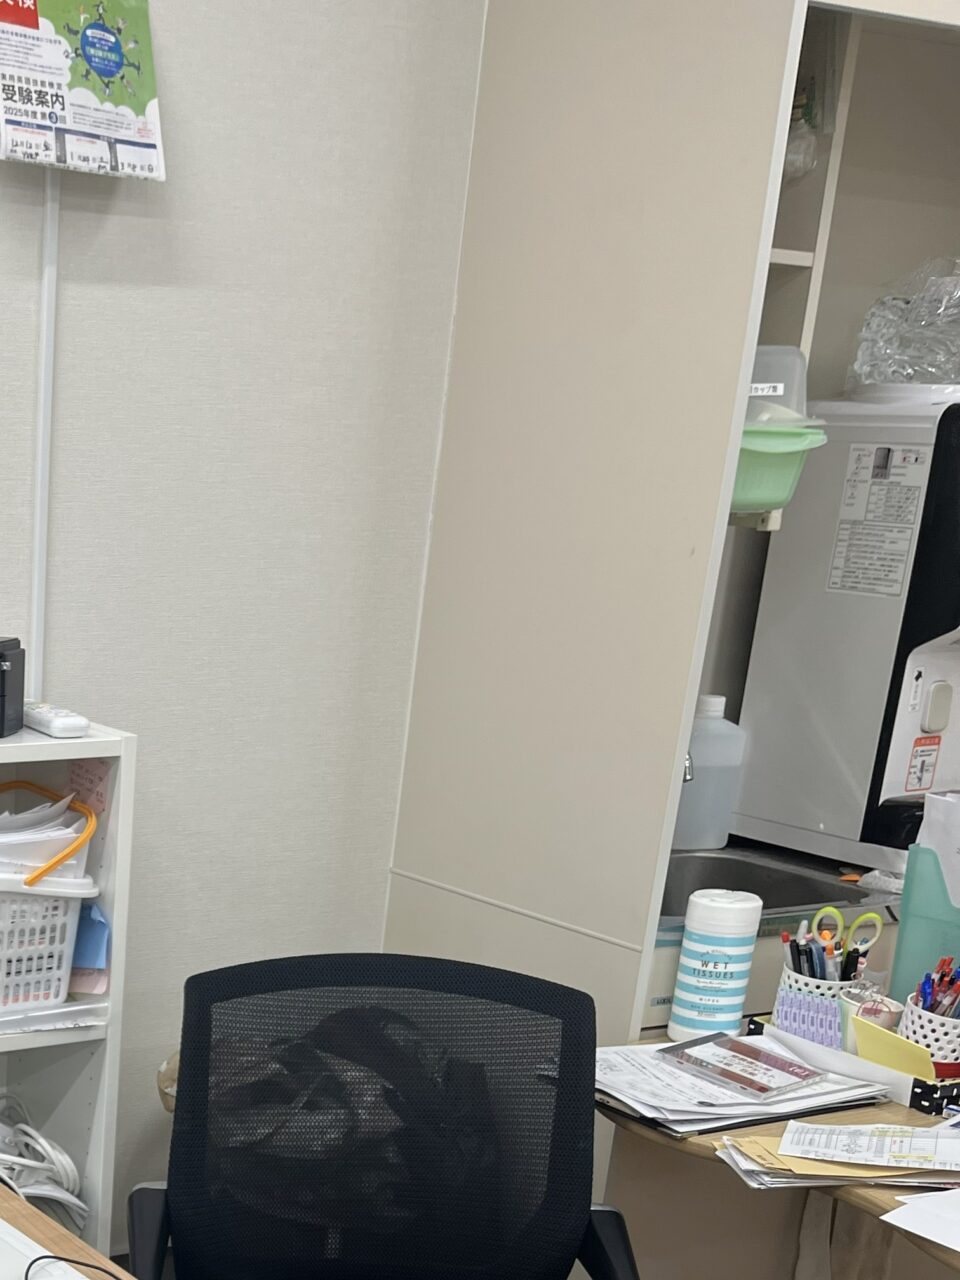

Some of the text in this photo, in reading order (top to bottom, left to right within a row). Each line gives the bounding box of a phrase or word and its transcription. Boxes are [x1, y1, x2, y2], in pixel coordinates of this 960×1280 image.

[1, 84, 65, 111] 受験案内
[700, 960, 729, 970] WET
[691, 968, 735, 979] TISSUES
